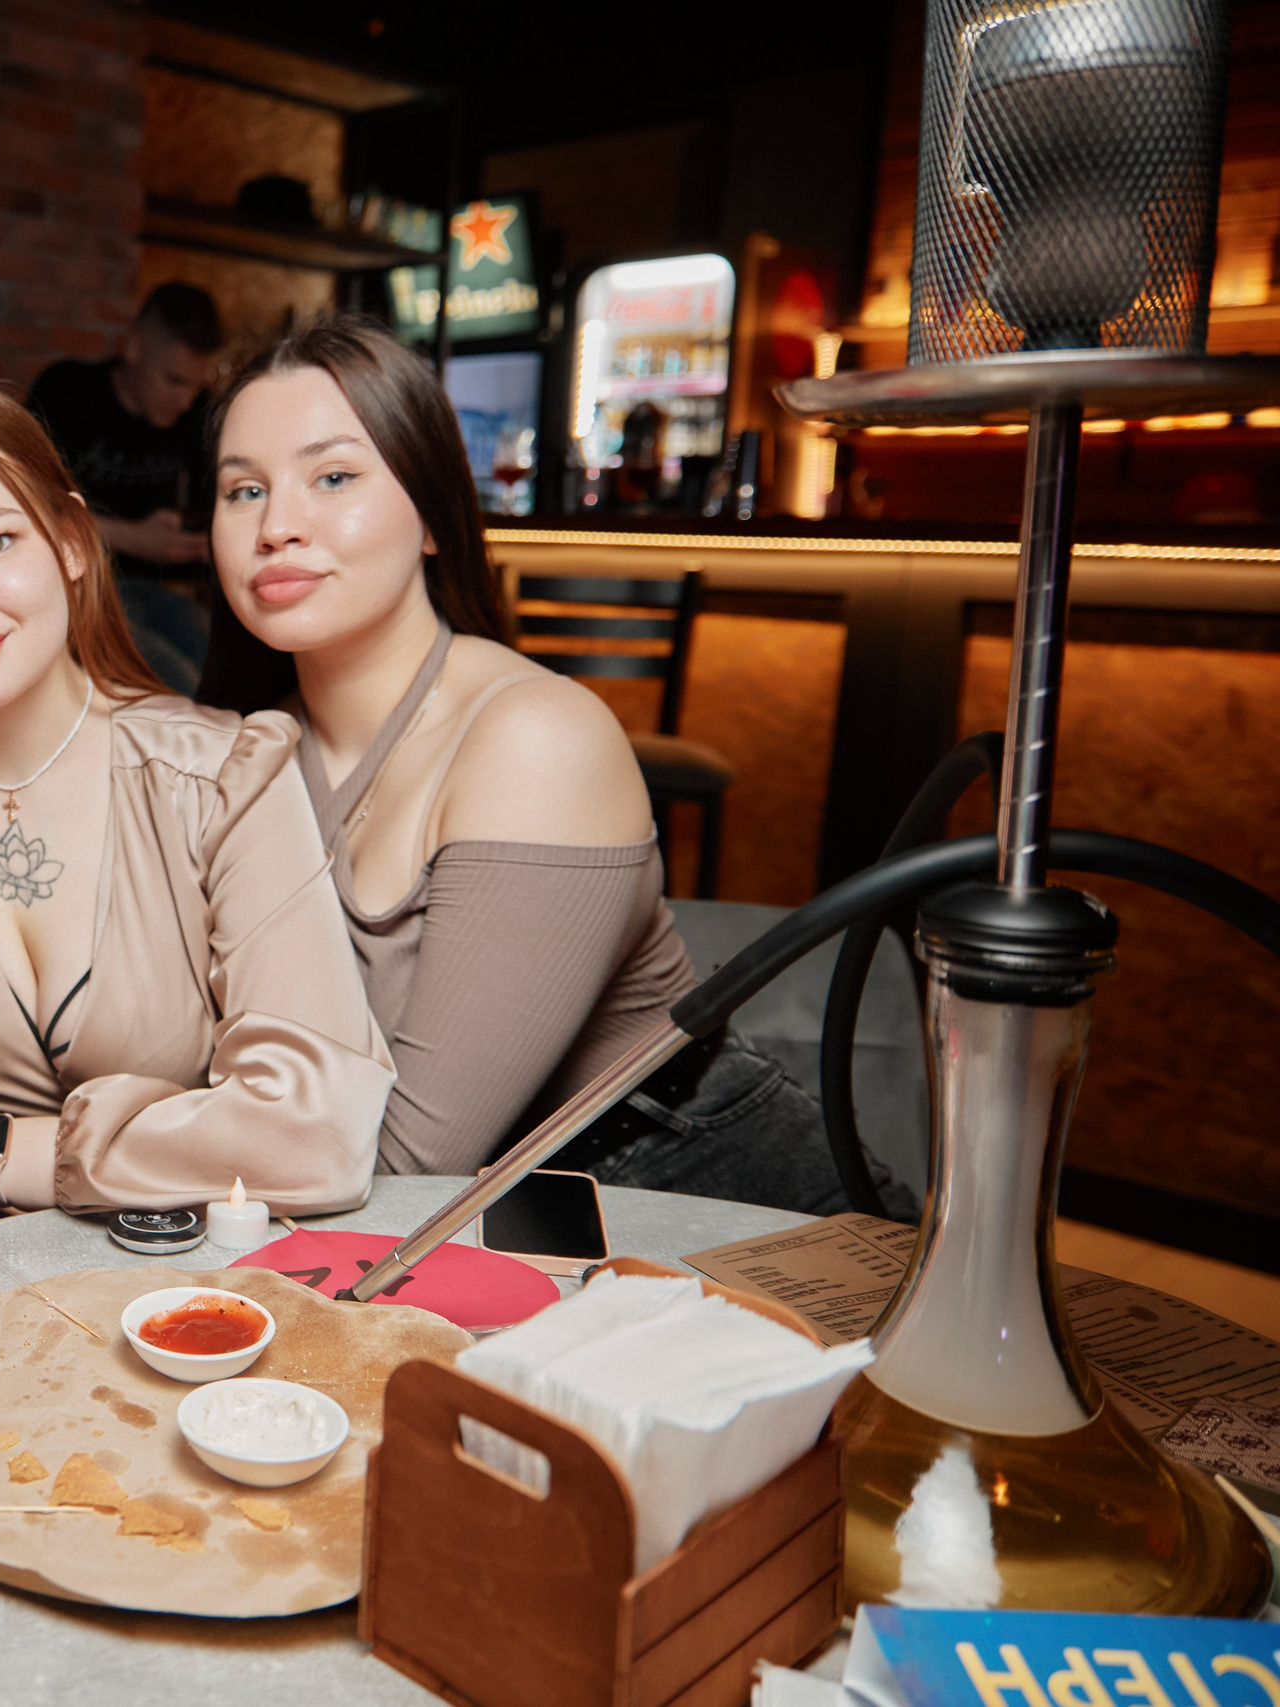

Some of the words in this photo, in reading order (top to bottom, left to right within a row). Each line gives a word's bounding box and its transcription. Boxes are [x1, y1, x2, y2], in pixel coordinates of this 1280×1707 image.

[874, 1228, 919, 1241] MARTIN
[825, 1297, 855, 1308] ВИНО
[855, 1290, 895, 1302] КРАСНО
